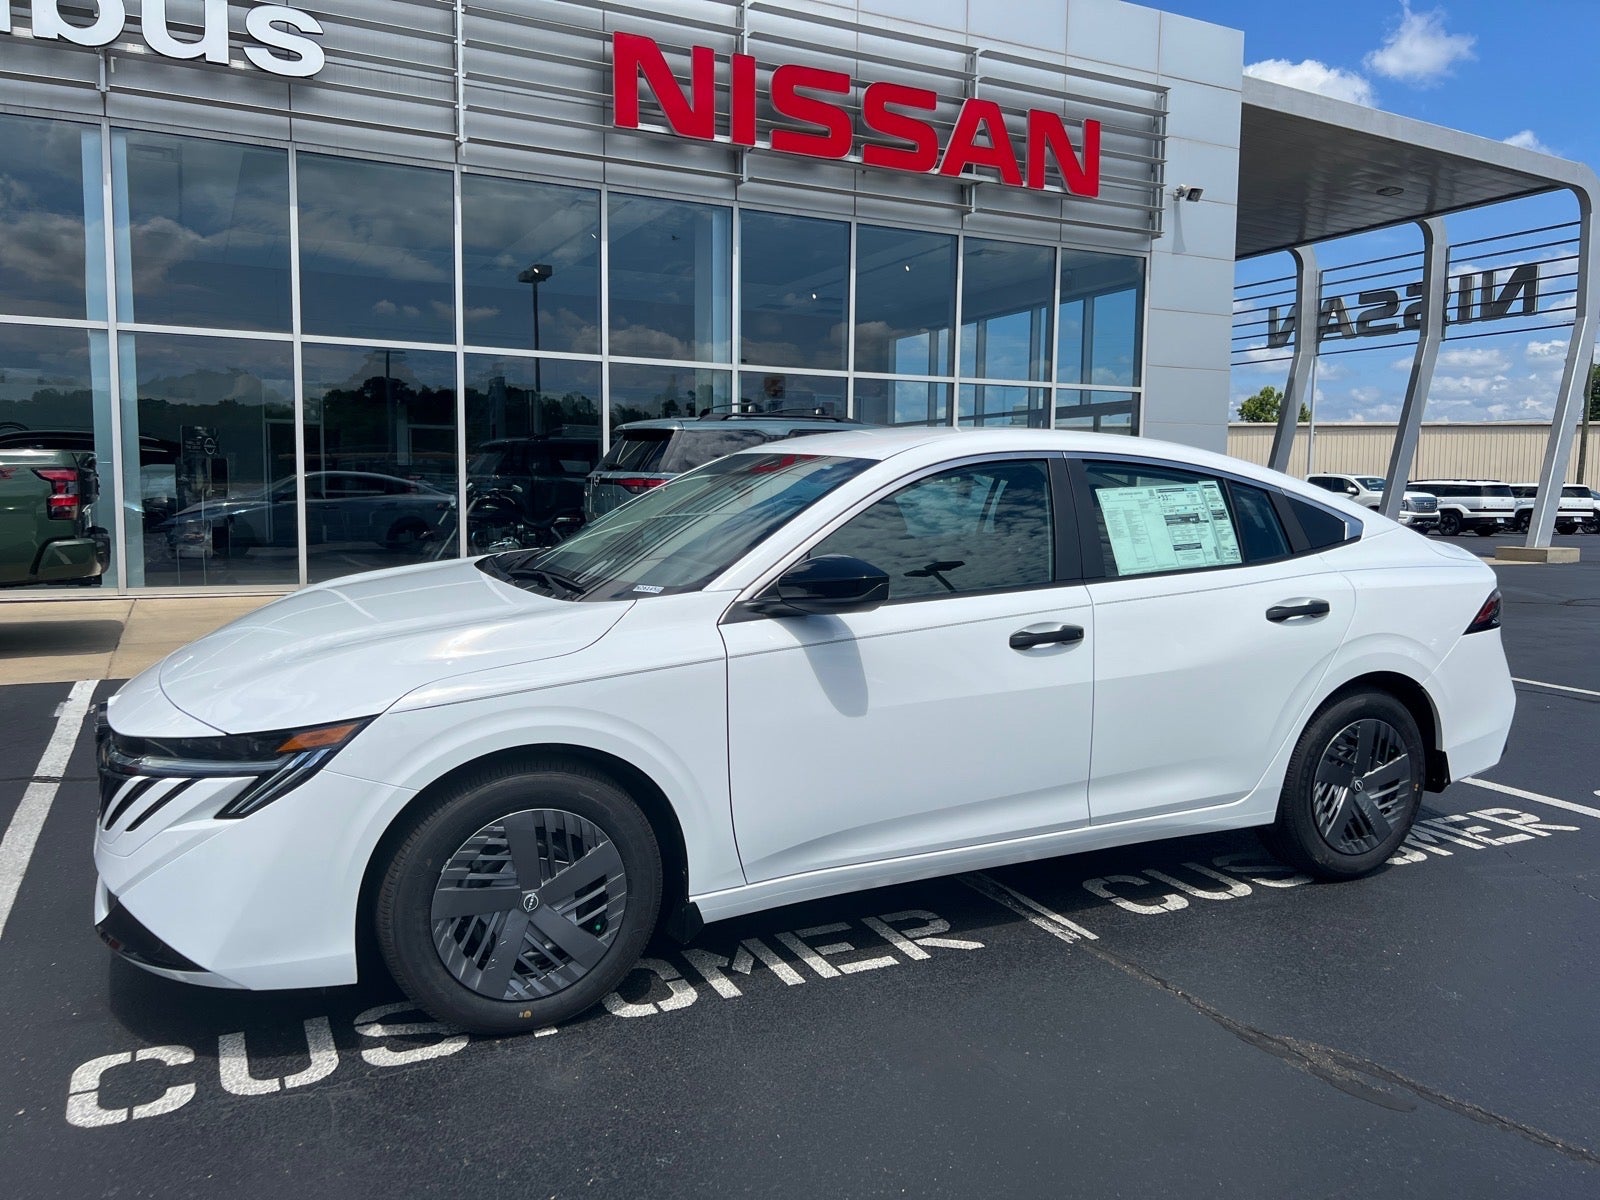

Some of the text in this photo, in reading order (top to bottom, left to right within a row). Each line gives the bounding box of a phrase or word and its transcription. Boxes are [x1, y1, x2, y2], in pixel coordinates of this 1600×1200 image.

[0, 0, 326, 78] bus
[612, 31, 1101, 199] NISSAN
[1082, 807, 1581, 915] CUSMER
[66, 909, 985, 1128] CUSOMER
